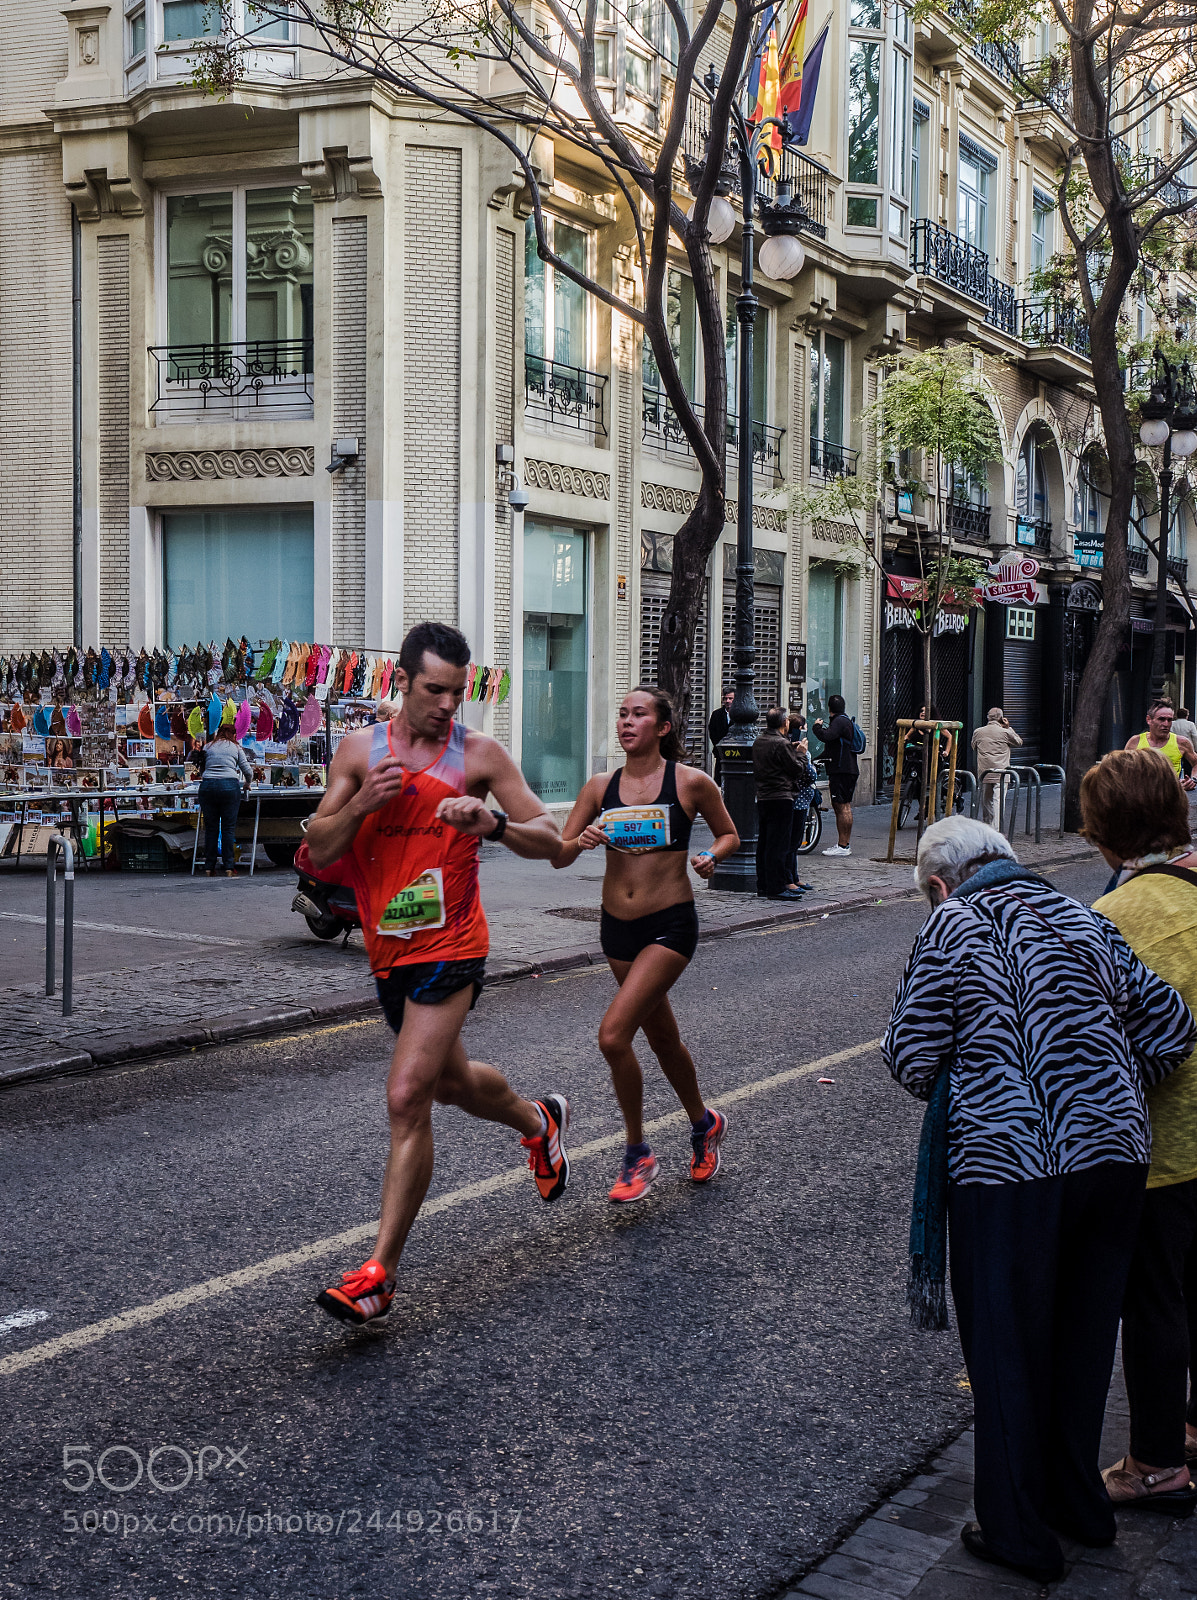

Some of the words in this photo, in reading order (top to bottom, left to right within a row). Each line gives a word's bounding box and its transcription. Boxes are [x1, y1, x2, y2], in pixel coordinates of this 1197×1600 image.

[992, 584, 1016, 595] SNACK
[936, 608, 965, 635] BELROS
[623, 822, 643, 832] 597
[614, 834, 657, 846] JOHANNES
